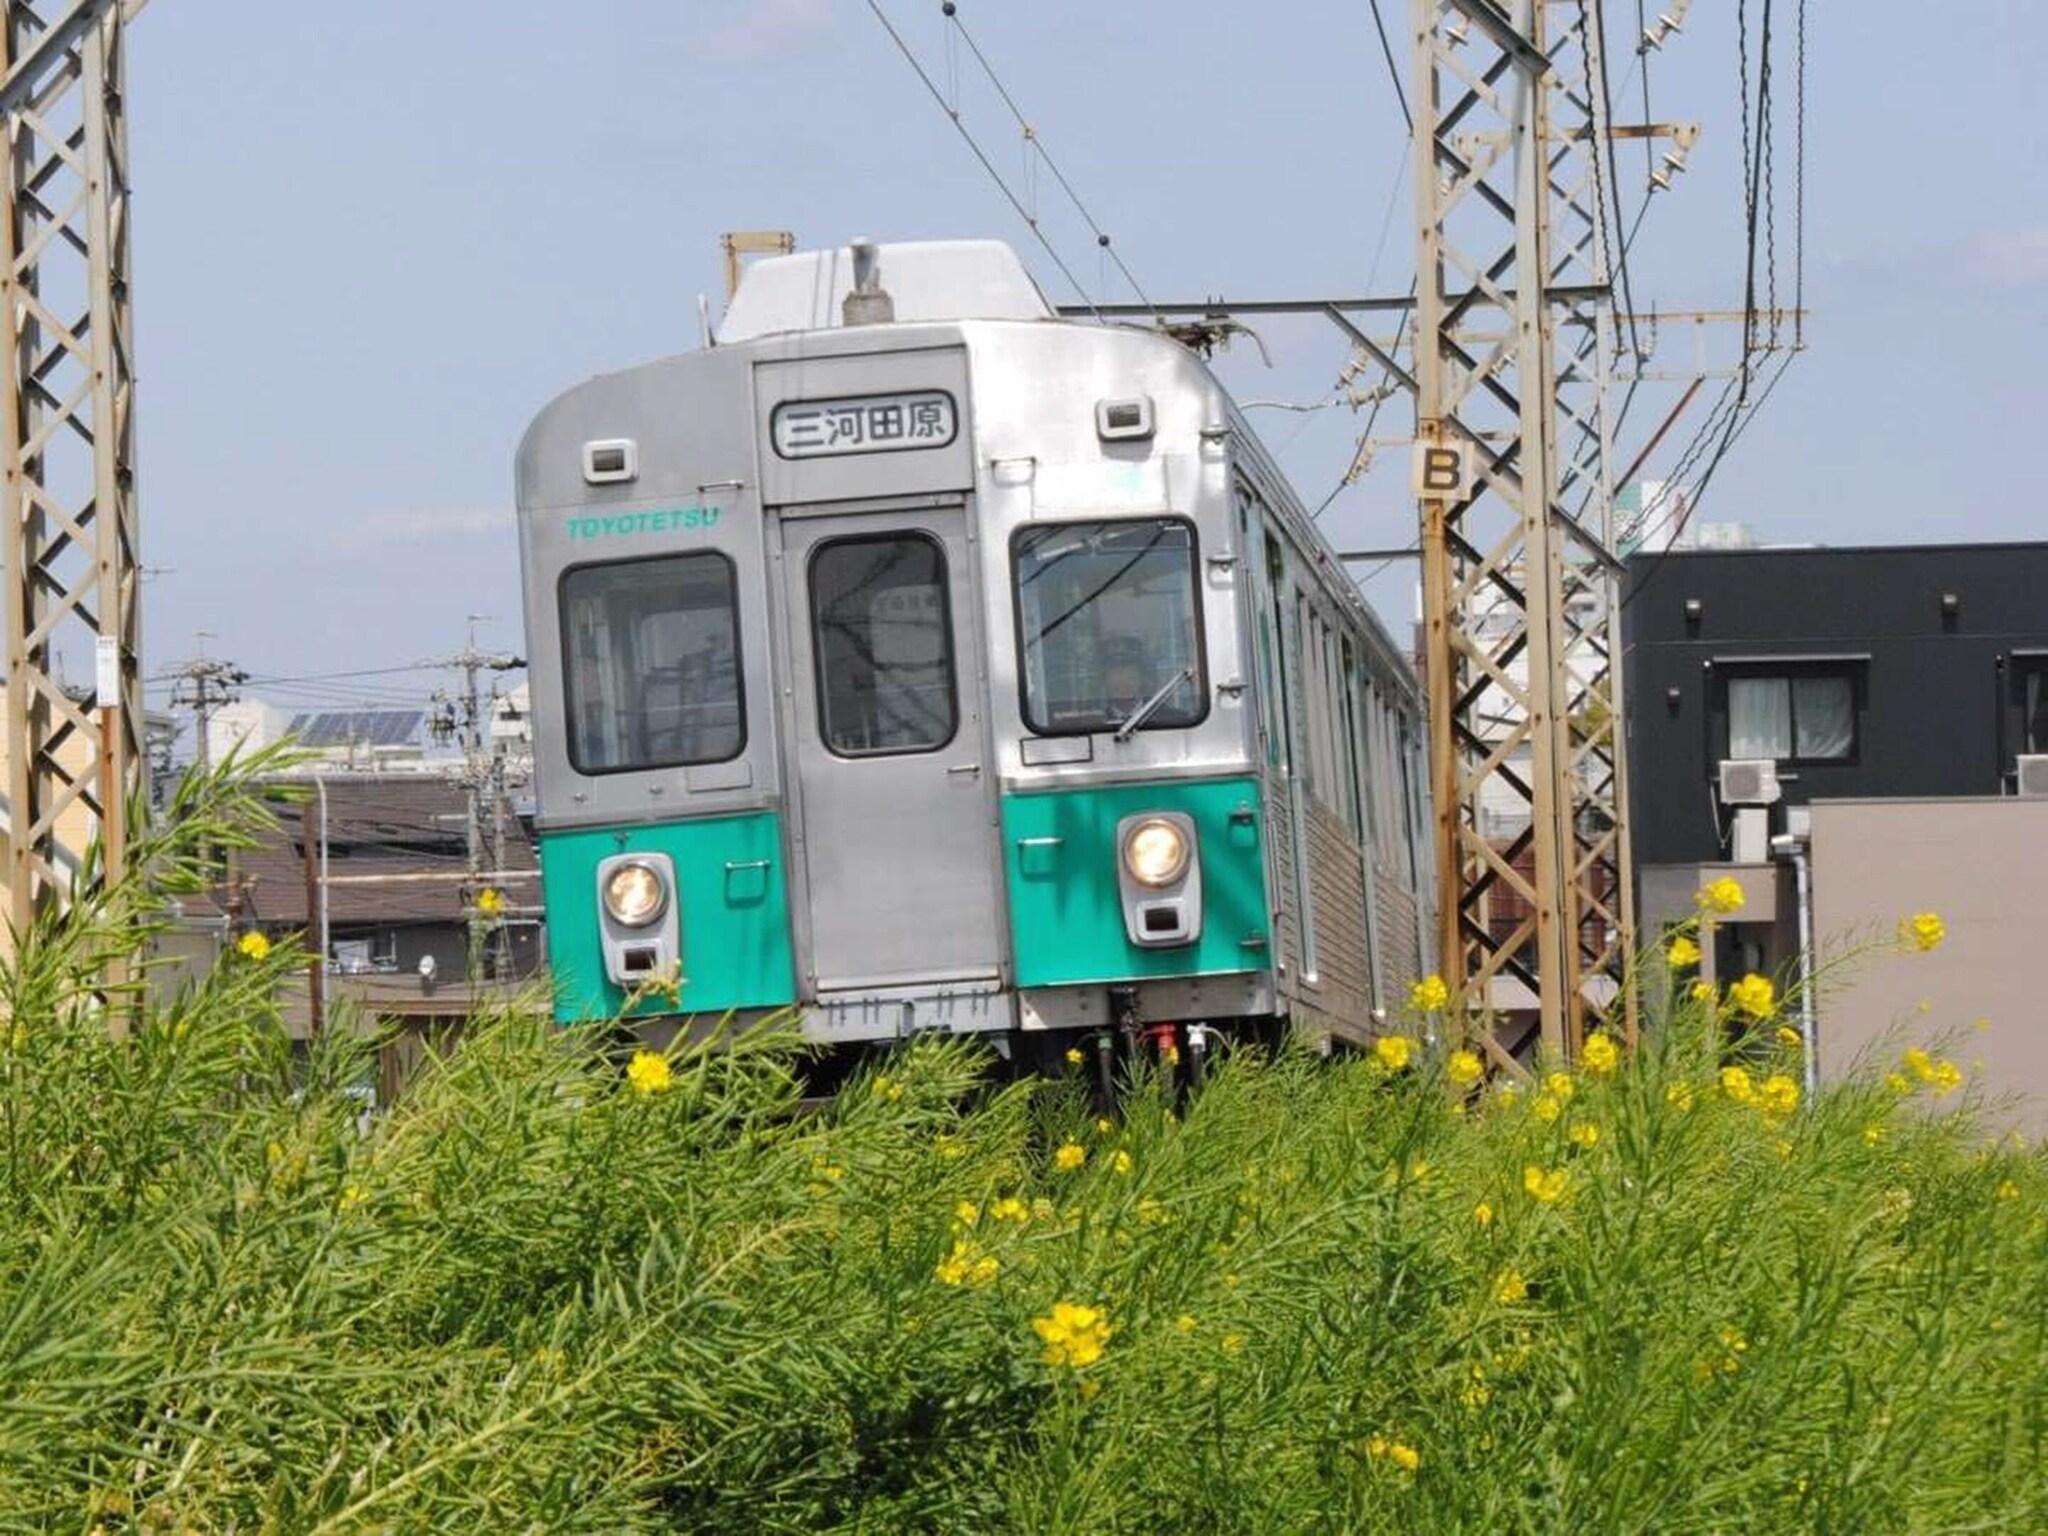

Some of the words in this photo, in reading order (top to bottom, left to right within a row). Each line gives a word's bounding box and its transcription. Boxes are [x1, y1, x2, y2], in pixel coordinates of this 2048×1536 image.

[787, 400, 945, 448] 三河田原
[1423, 448, 1460, 490] B
[566, 507, 719, 540] TOYOTETSU
